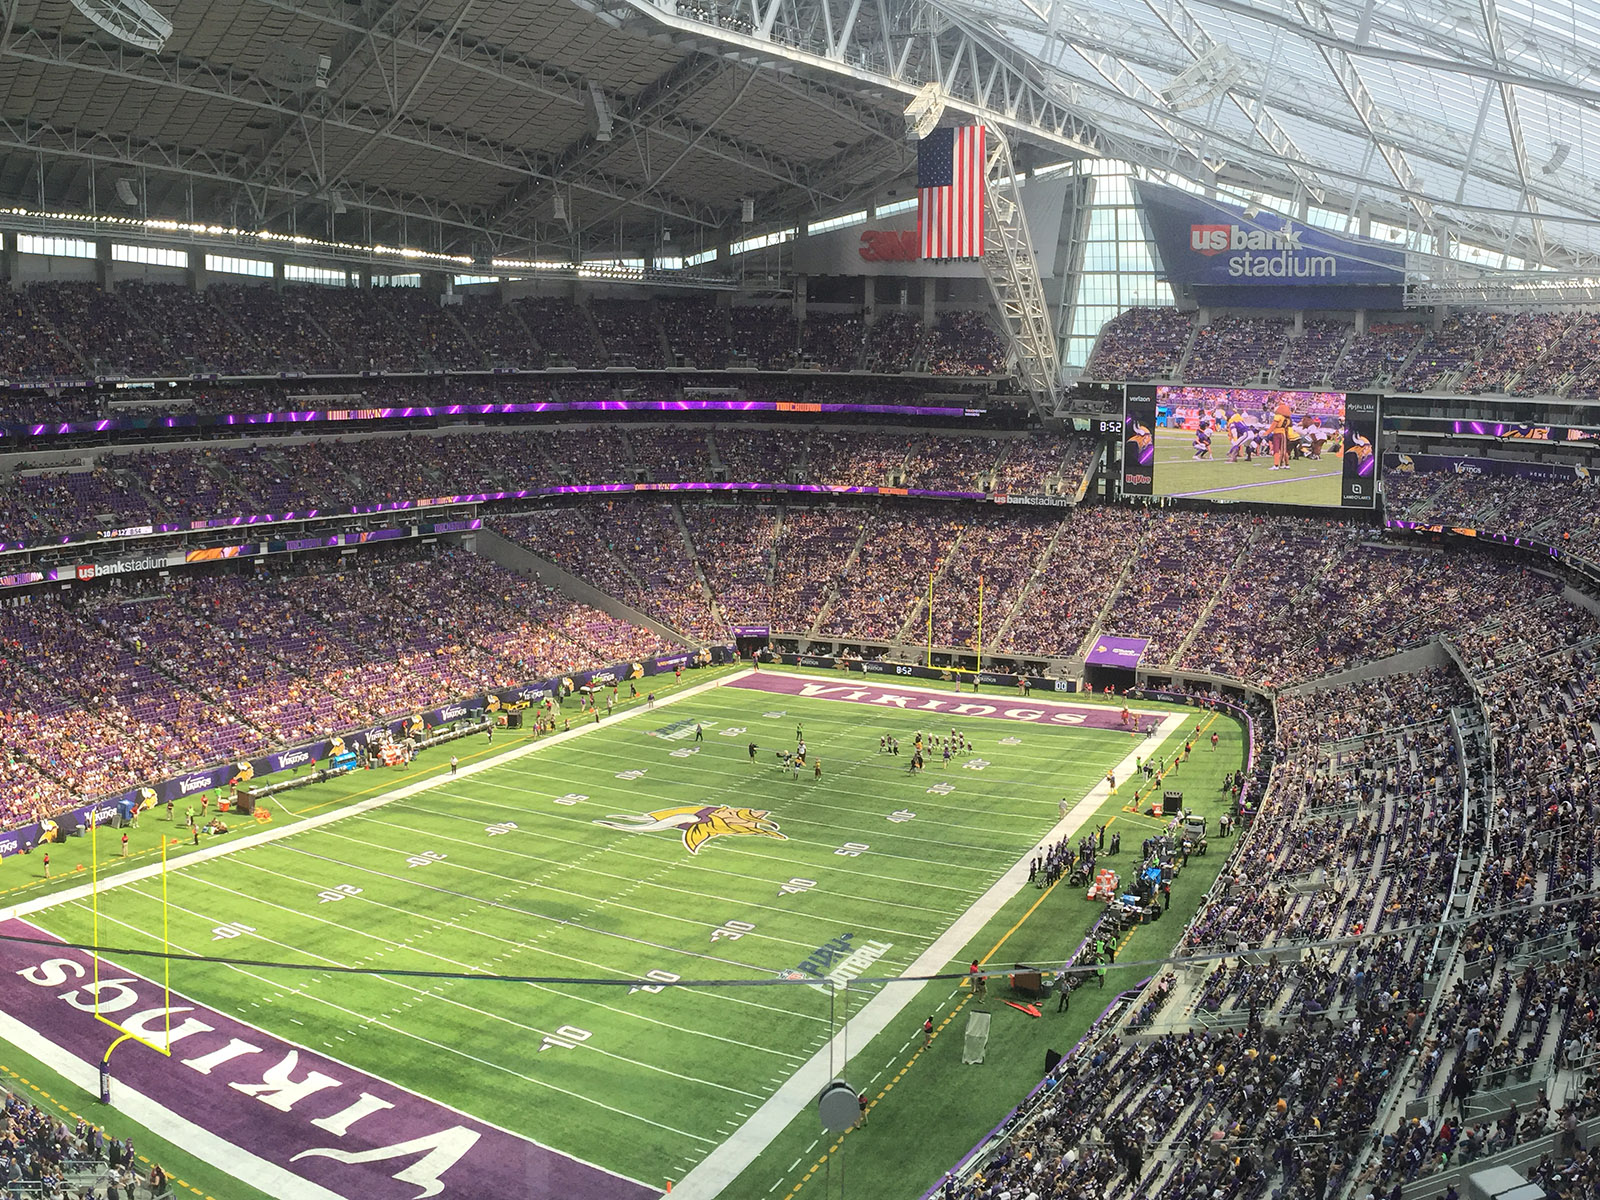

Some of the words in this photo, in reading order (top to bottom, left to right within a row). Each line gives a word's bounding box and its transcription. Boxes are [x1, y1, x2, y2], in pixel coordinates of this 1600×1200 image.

[1228, 251, 1337, 277] stadium
[1100, 421, 1122, 432] 8:52
[896, 665, 912, 675] 8:52
[799, 682, 1089, 723] VIKINGS
[278, 752, 309, 769] VIKINGS
[180, 776, 212, 795] VIKINGS
[405, 850, 448, 867] 30
[833, 842, 870, 857] 50
[317, 883, 364, 902] 20
[782, 877, 818, 894] 40
[211, 921, 257, 939] 10
[714, 920, 756, 941] 30
[542, 1024, 593, 1050] 10
[16, 958, 482, 1200] VIKINGS
